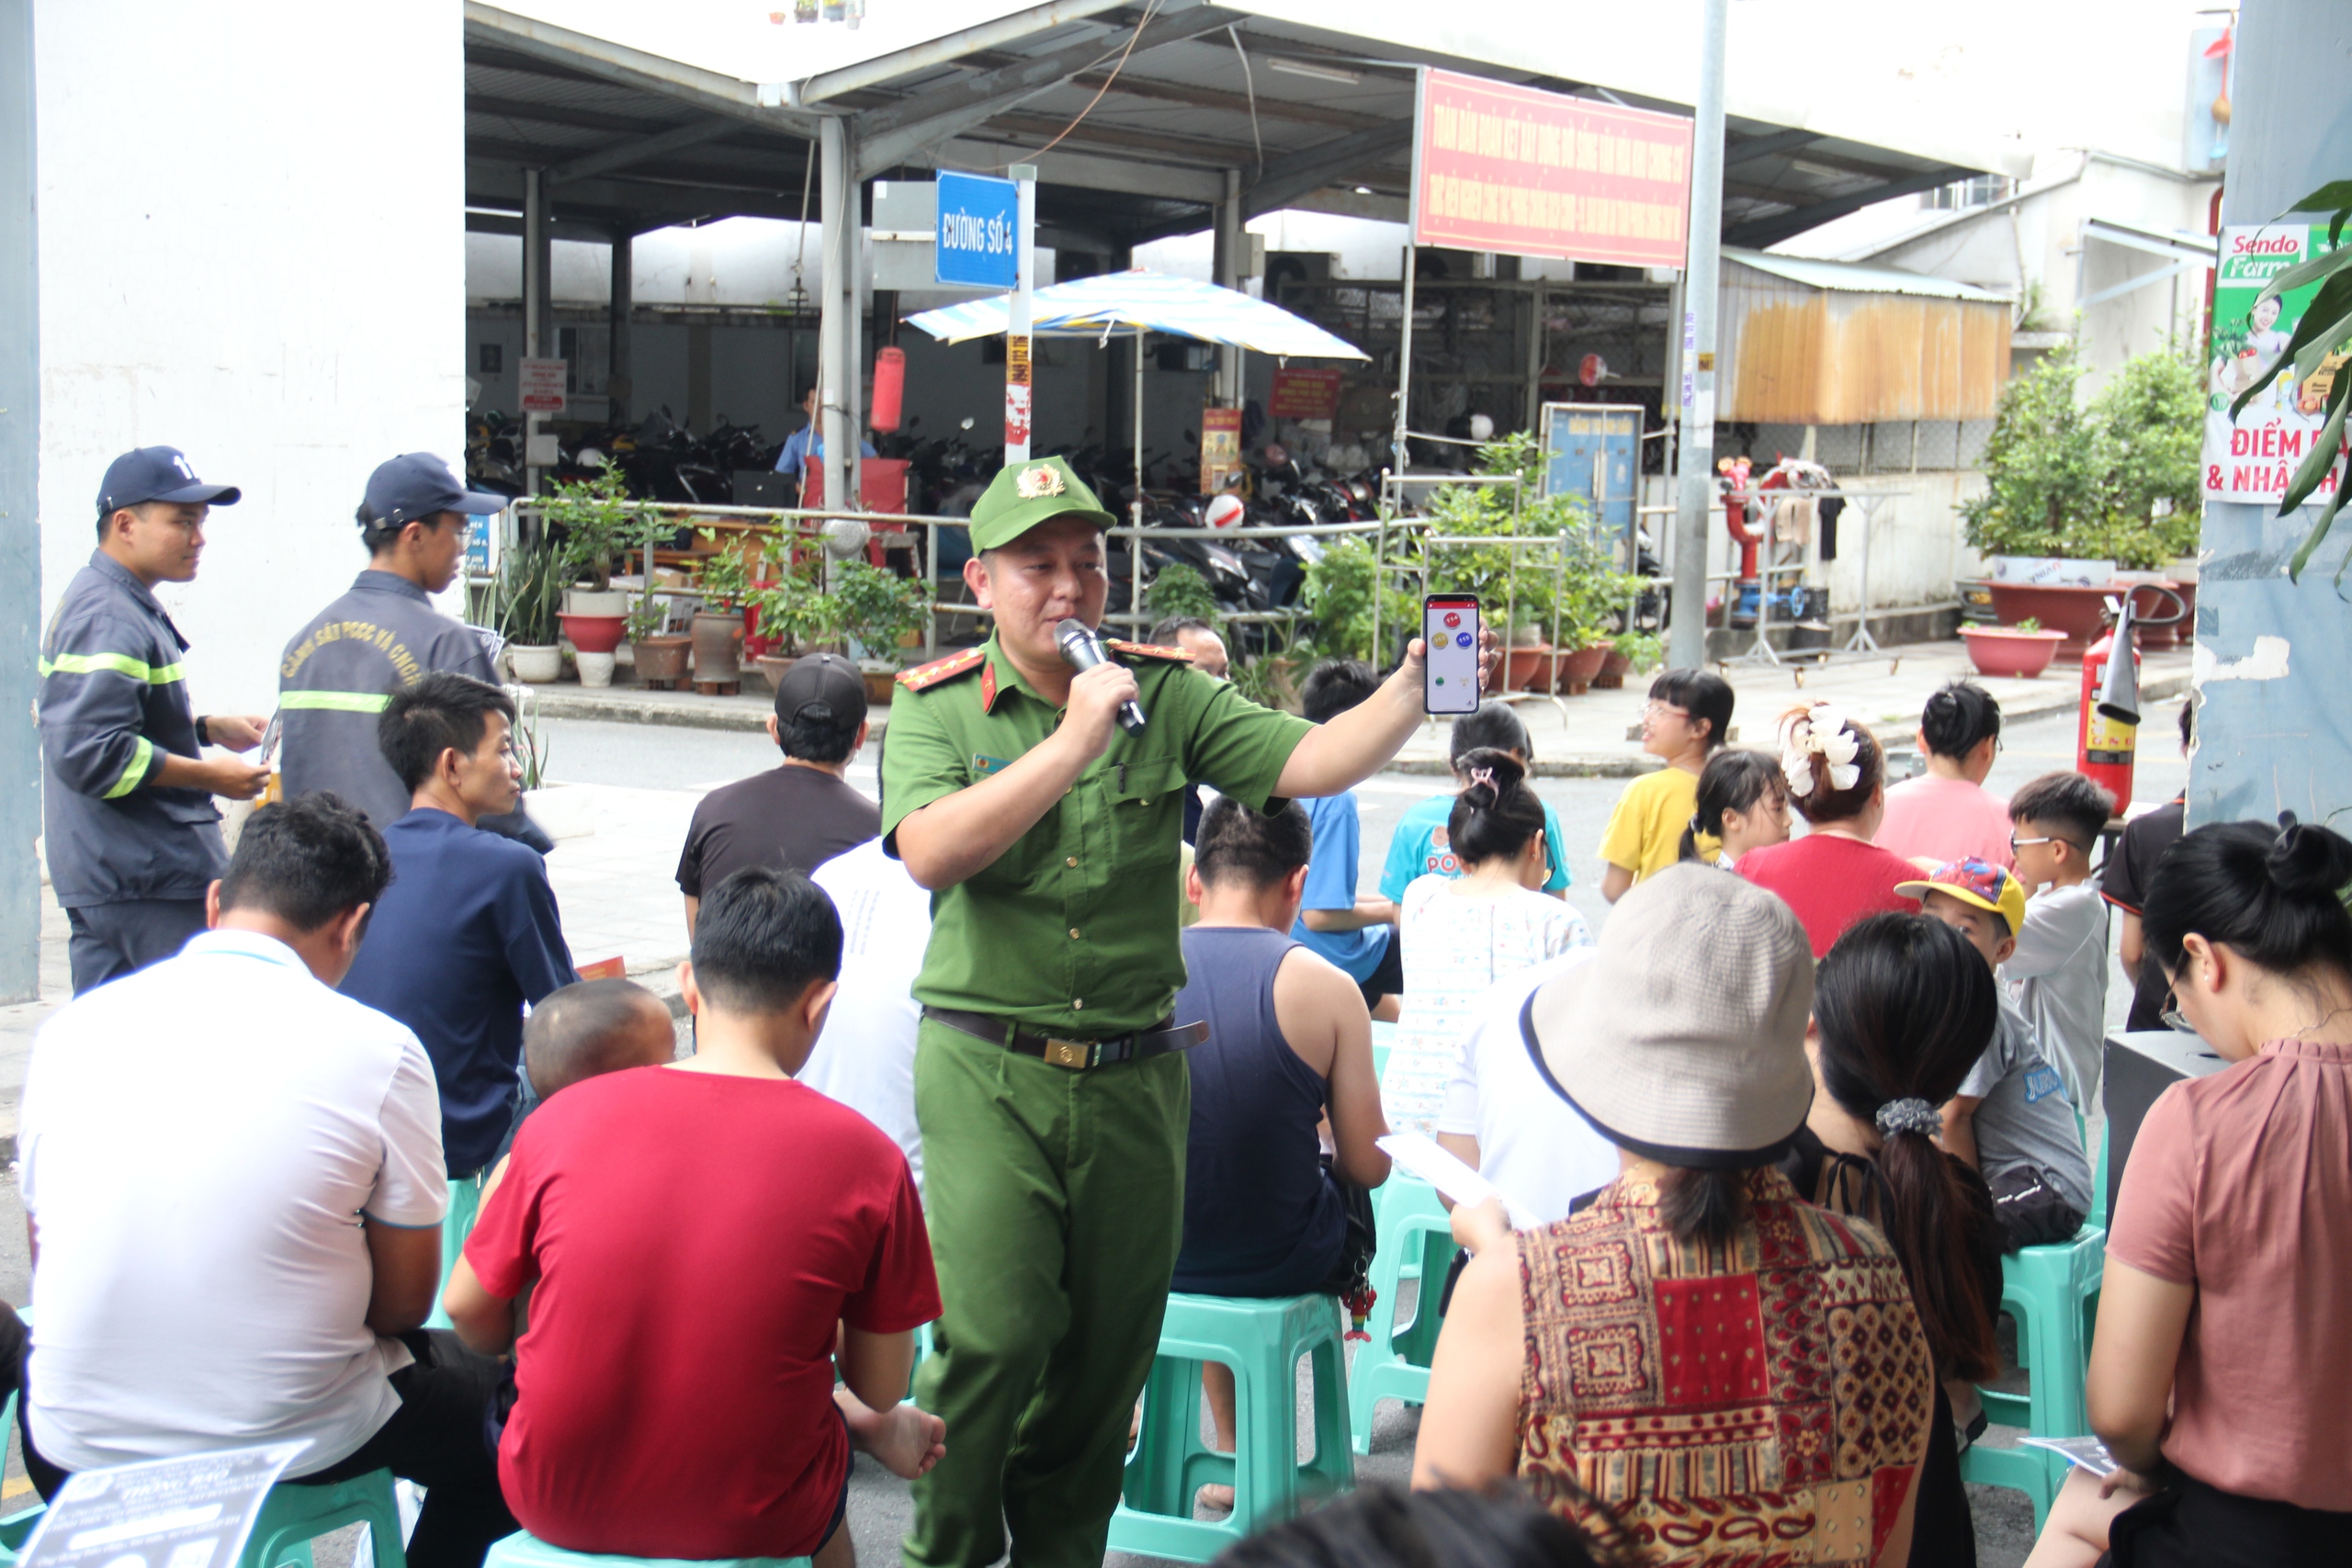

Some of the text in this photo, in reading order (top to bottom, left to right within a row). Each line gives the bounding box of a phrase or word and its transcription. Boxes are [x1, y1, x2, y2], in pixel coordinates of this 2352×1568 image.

[943, 207, 1013, 255] ĐƯỜNG SỐ 4
[2232, 234, 2299, 254] Sendo
[2230, 417, 2301, 457] ĐIỂM
[2206, 464, 2223, 491] &
[2233, 459, 2299, 499] NHẬ
